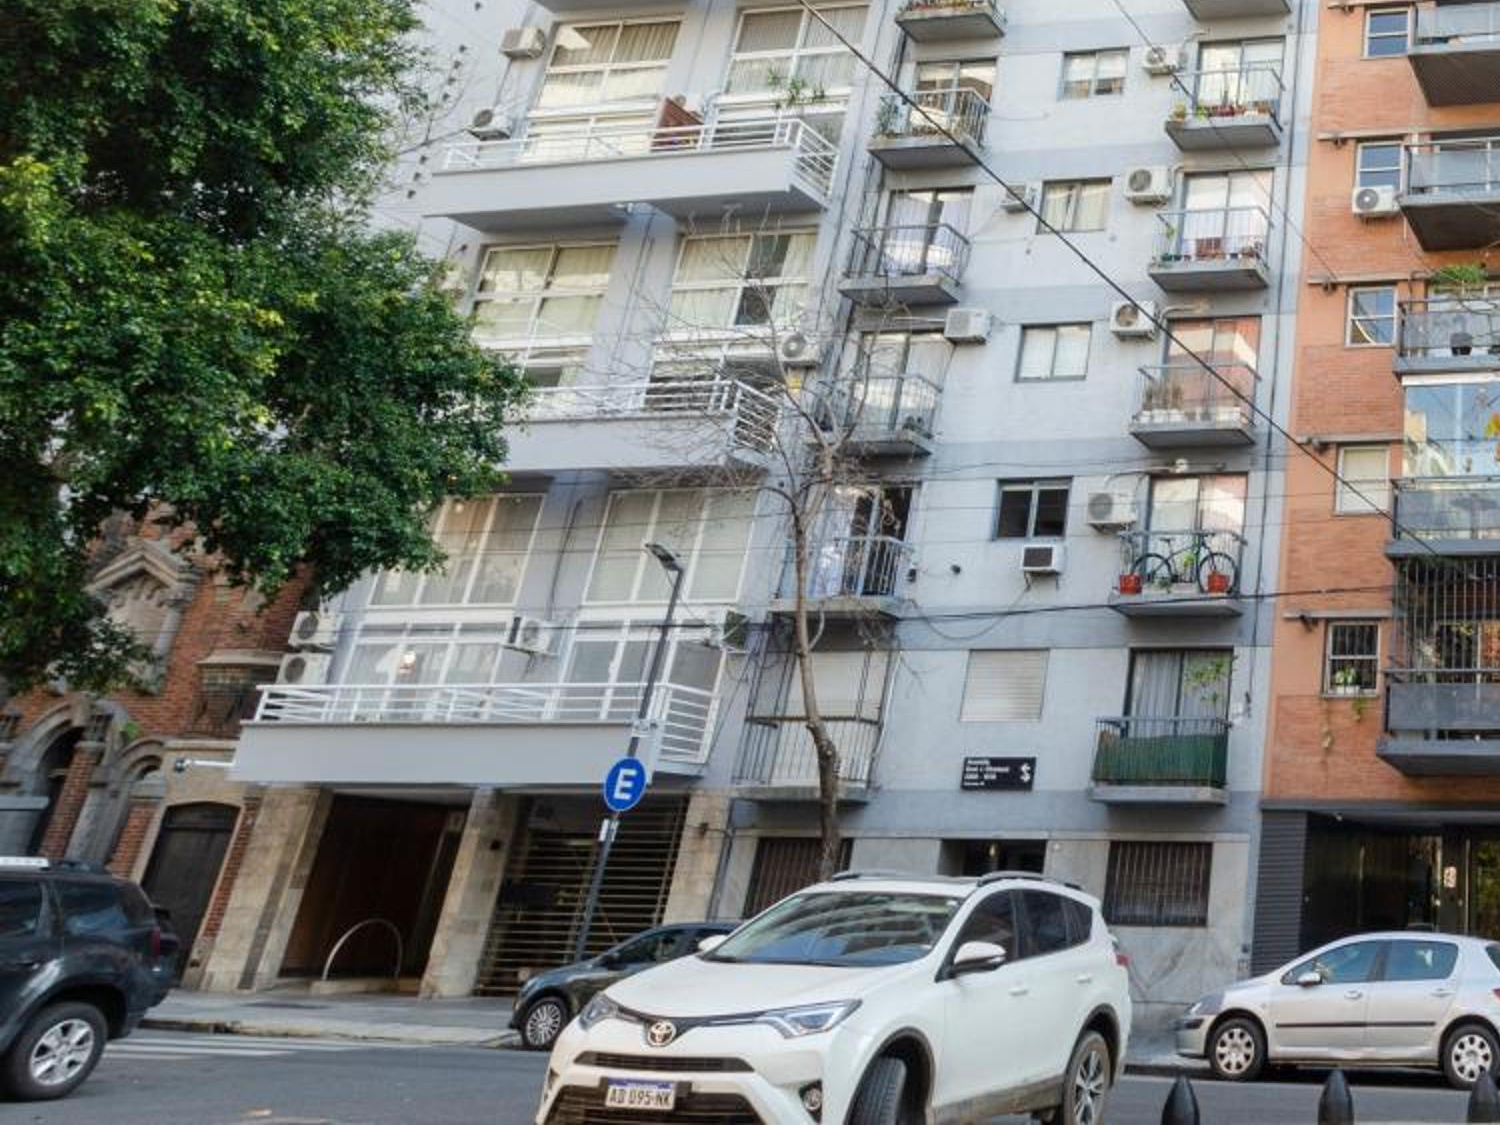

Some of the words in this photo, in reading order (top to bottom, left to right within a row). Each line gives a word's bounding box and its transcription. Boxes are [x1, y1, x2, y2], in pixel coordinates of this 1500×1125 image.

[613, 768, 638, 801] E
[609, 1088, 625, 1104] AD
[628, 1089, 651, 1105] 095
